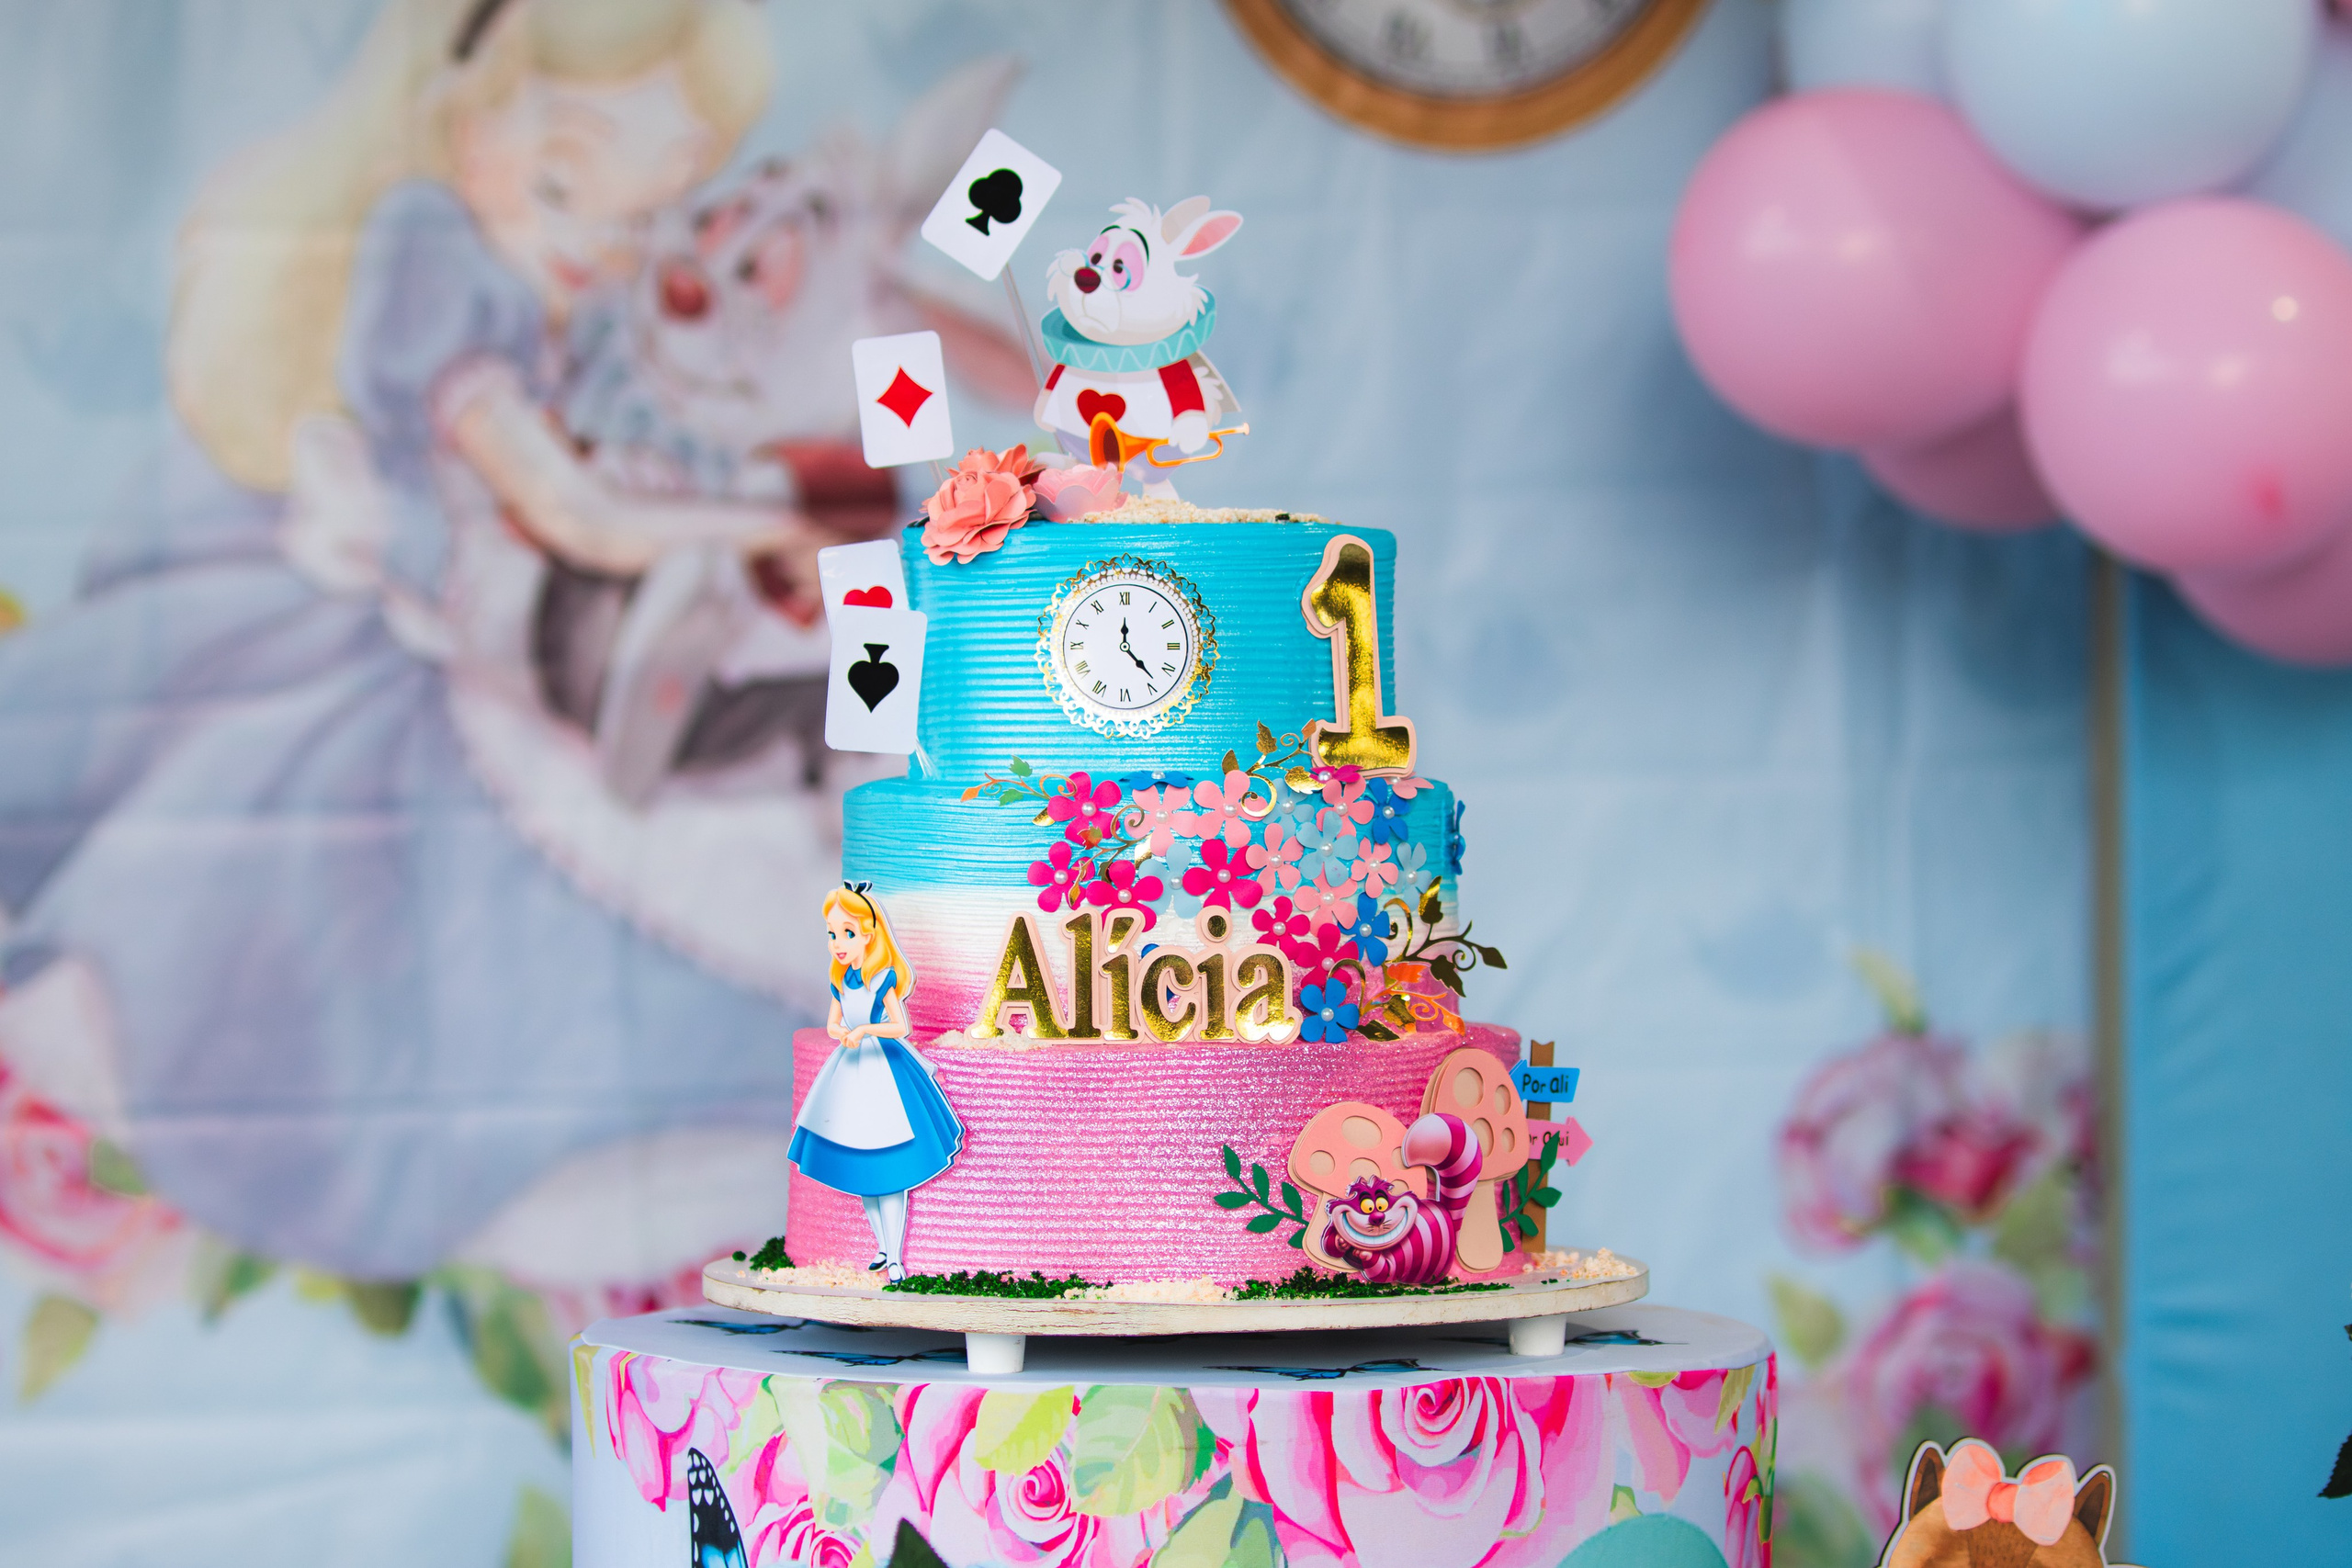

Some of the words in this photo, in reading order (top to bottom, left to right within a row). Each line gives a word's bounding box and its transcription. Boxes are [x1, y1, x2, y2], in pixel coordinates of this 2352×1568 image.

[1119, 592, 1131, 606] XII
[1091, 600, 1104, 615] XI
[1076, 619, 1090, 630] X
[1161, 619, 1175, 629] II
[1070, 641, 1084, 650] IX
[1167, 642, 1181, 650] III
[1310, 542, 1410, 770] 1
[1161, 661, 1176, 678] IV
[1091, 680, 1107, 698] VII
[1120, 688, 1132, 703] VI
[1147, 682, 1159, 696] V
[1522, 1073, 1546, 1094] Por
[1550, 1074, 1569, 1094] ali
[1543, 1131, 1569, 1146] aui
